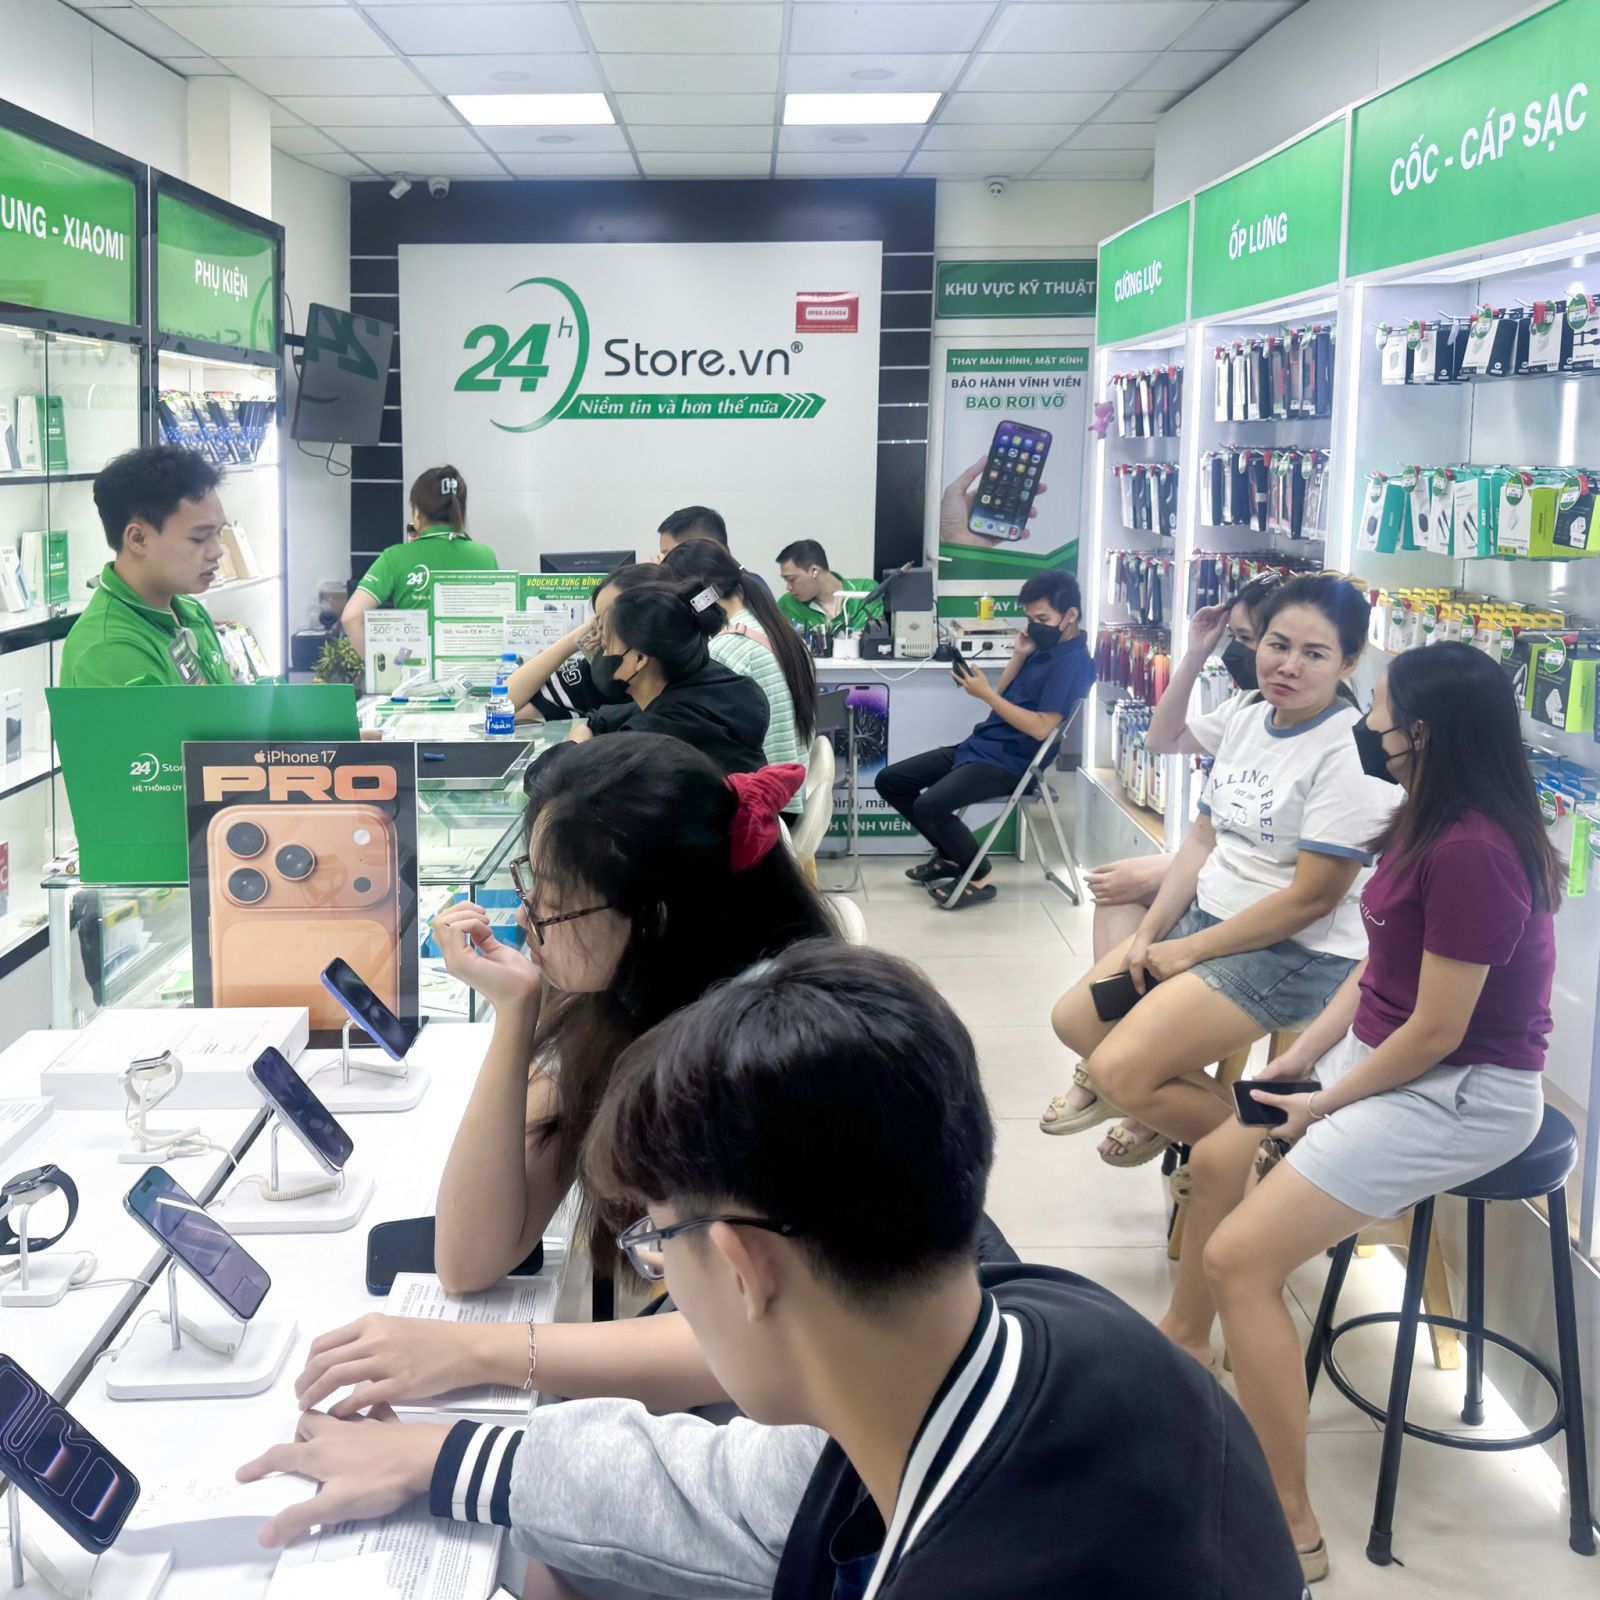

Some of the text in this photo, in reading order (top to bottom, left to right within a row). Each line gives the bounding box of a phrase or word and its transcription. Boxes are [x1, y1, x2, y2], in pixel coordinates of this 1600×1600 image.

[1390, 134, 1438, 197] CỐC
[1460, 107, 1516, 170] CÁP
[1522, 82, 1588, 152] SẠC
[63, 214, 124, 261] XIAOMI
[1228, 211, 1288, 261] ỐP LƯNG
[194, 259, 249, 301] PHỤ KIỆN
[945, 279, 1095, 298] KHU VỰC KỸ THUẬT
[1114, 260, 1163, 302] CƯỜNG LỰC
[951, 355, 1084, 366] THAY MÀN HÌNH, MẶT KÍNH
[951, 376, 977, 389] BẢO
[980, 376, 1016, 388] HÀNH
[1019, 376, 1049, 388] VĨNH
[578, 392, 779, 415] Niềm tin và hơn thế nữa
[966, 392, 1066, 409] BAO RƠI VỠ
[527, 578, 559, 587] VOUCHER
[974, 601, 1010, 611] TAY
[267, 750, 337, 764] iPhone 17
[202, 765, 398, 802] PRO
[1260, 788, 1274, 843] FREE
